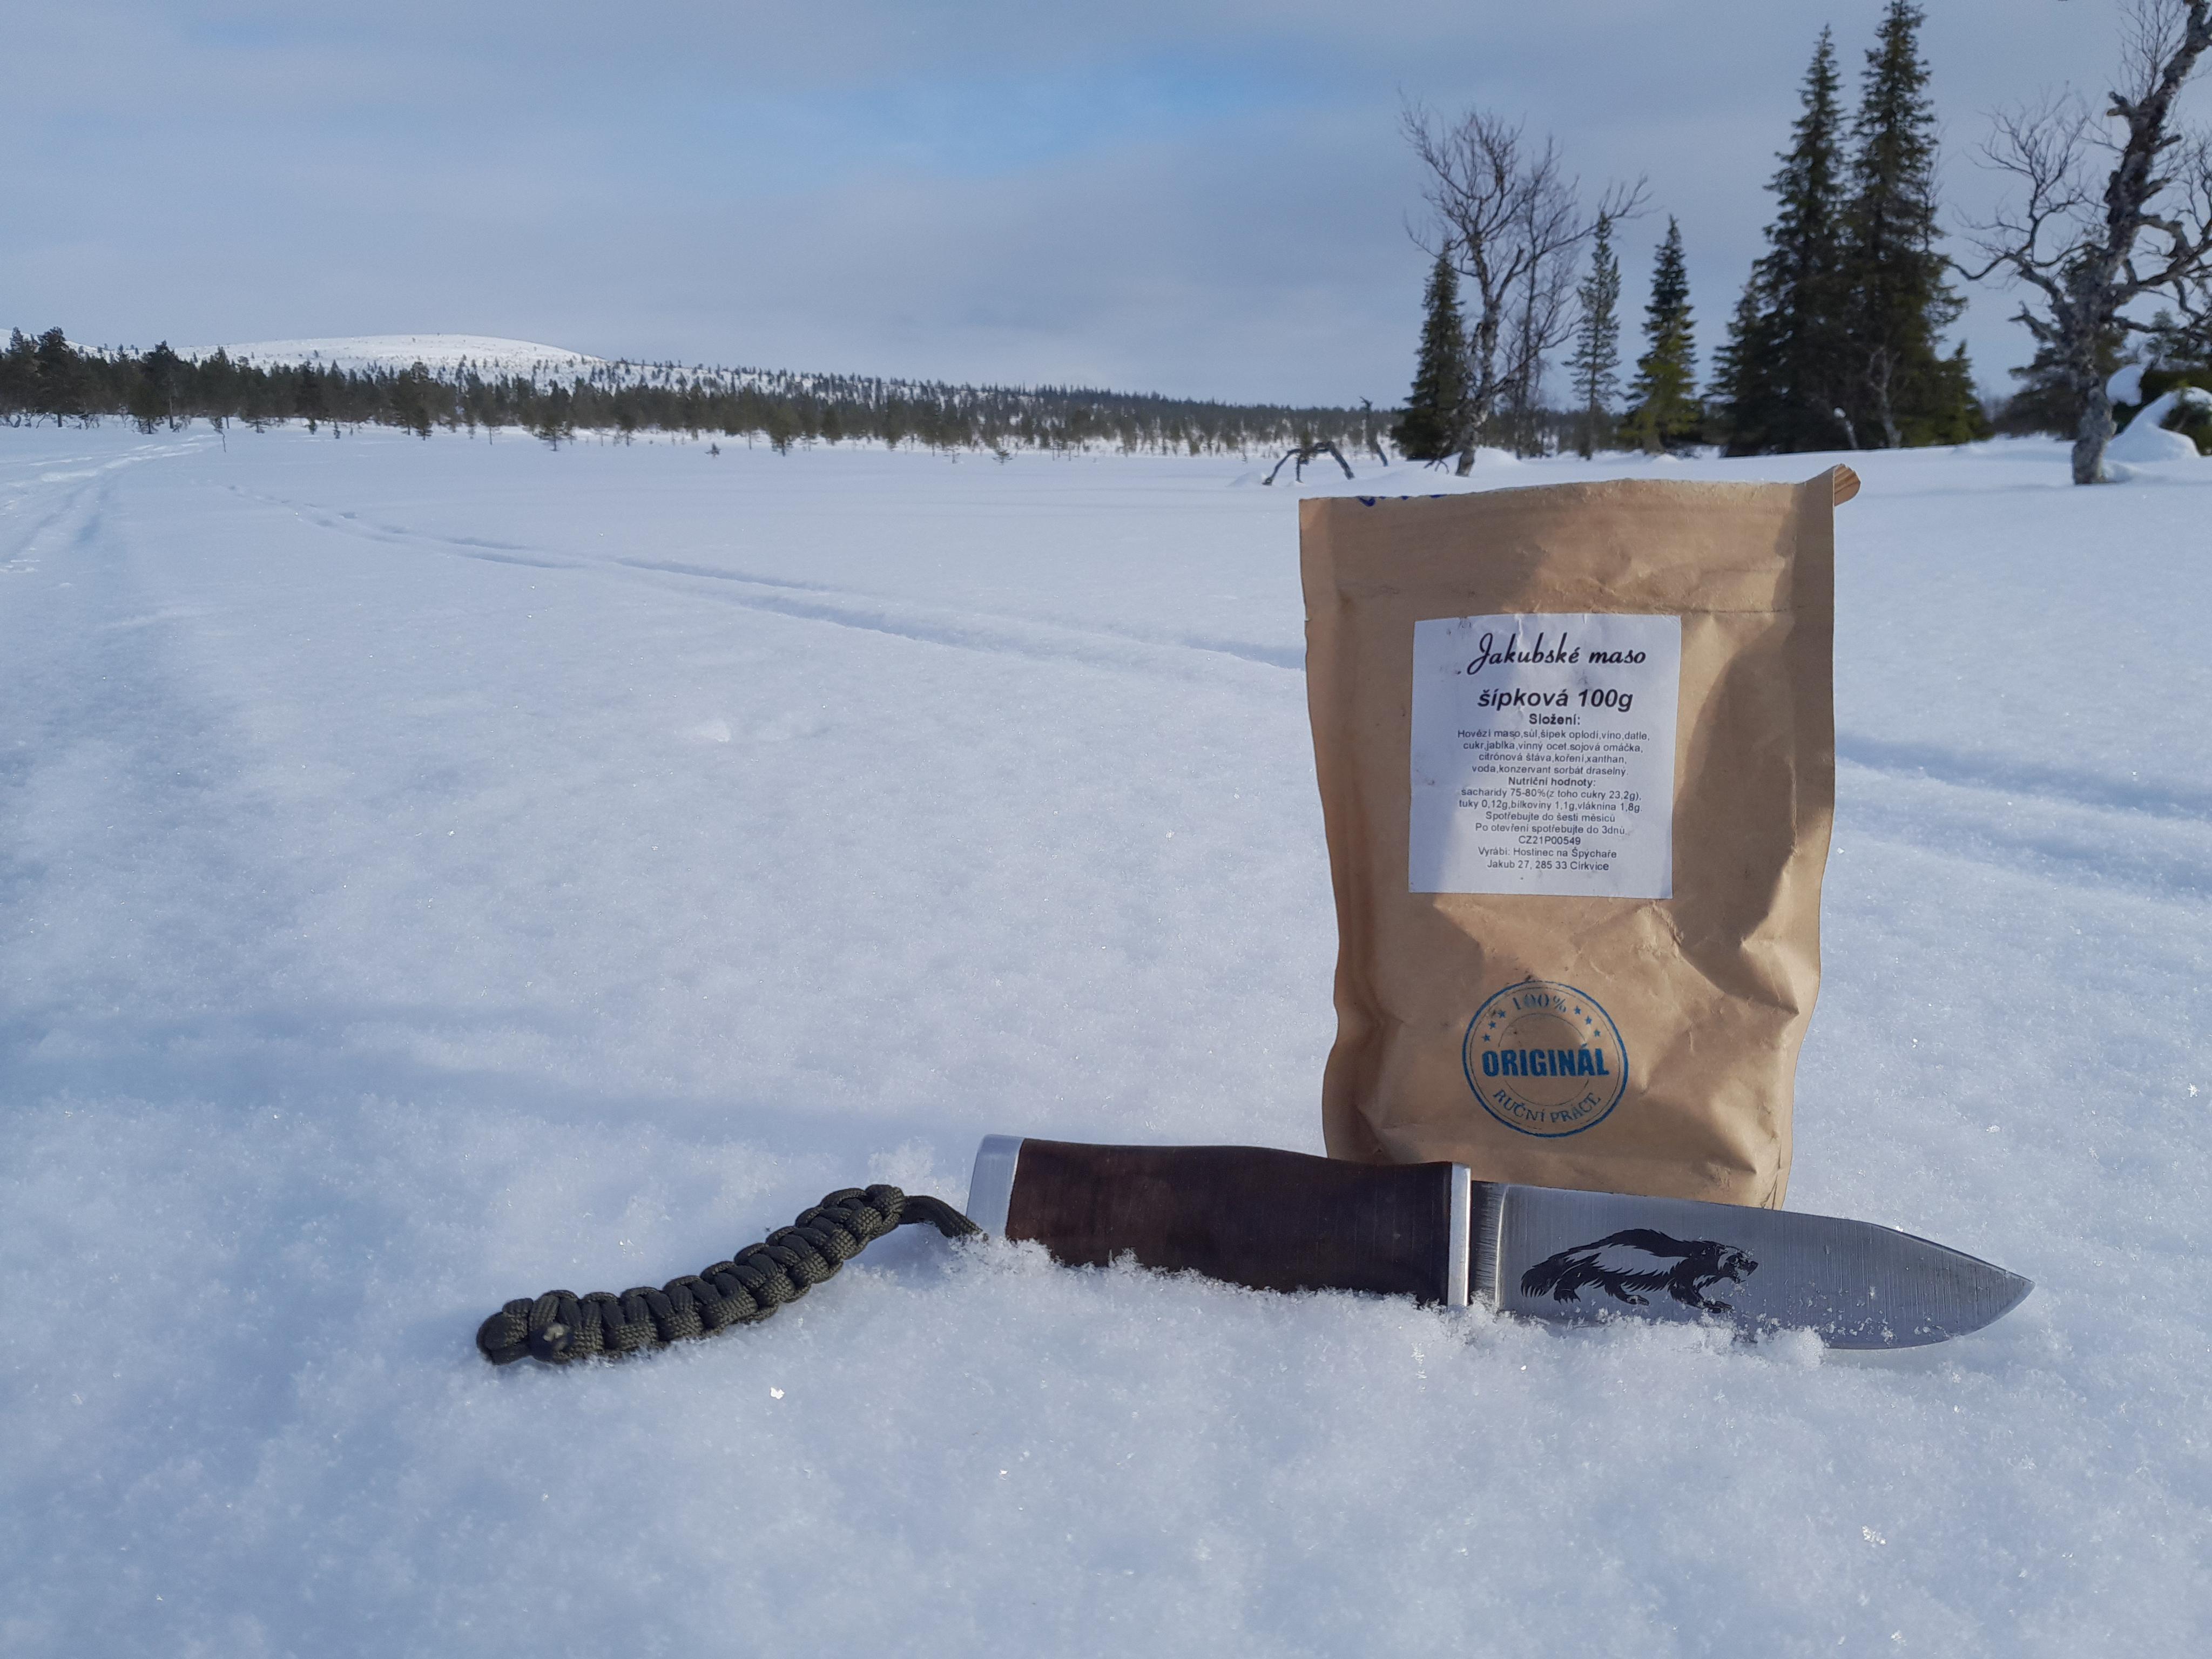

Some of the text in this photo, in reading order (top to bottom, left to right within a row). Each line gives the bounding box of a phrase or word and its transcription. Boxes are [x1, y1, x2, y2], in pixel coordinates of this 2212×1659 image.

[1467, 632, 1646, 675] Jakubské maso
[1478, 689, 1634, 712] šípková 100g
[1529, 713, 1581, 725] Složení:
[1554, 766, 1583, 775] sorbát
[1508, 777, 1596, 788] Nutriční hodnoty:
[1461, 788, 1507, 798] sacharidy
[1557, 790, 1578, 798] toho
[1581, 790, 1606, 800] cukry
[1459, 799, 1479, 810] tuky
[1486, 811, 1539, 822] Spotřebujte
[1542, 813, 1554, 821] do
[1556, 813, 1578, 821] šesti
[1475, 822, 1488, 832] Po
[1491, 824, 1529, 832] otevření
[1532, 824, 1583, 835] spotřebujte
[1587, 825, 1599, 834] do
[1519, 835, 1581, 845] CZ21P00549
[1513, 847, 1554, 857] Hostinec
[1572, 847, 1617, 859] Špýchaře
[1487, 860, 1515, 868] Jakub
[1518, 860, 1533, 870] 27,
[1535, 860, 1553, 869] 285
[1555, 861, 1567, 869] 33
[1513, 994, 1566, 1013] 100%
[1482, 1043, 1610, 1077] ORIGINÁL
[1493, 1089, 1545, 1123] RUČNÍ
